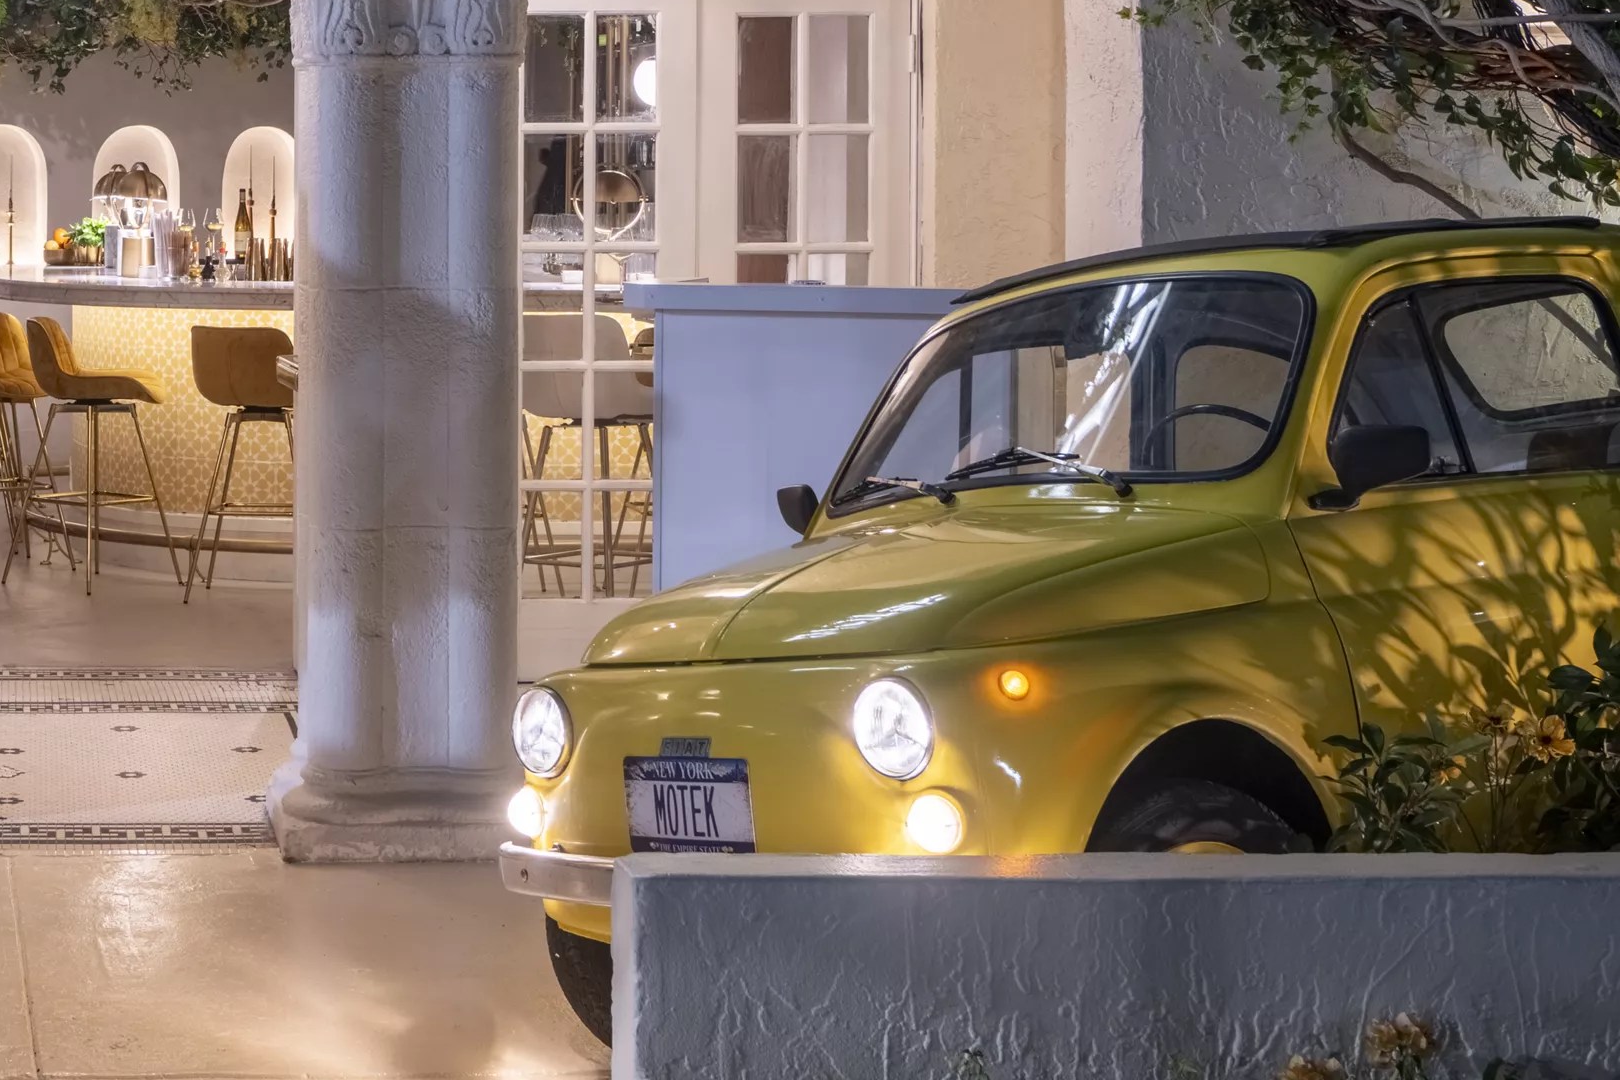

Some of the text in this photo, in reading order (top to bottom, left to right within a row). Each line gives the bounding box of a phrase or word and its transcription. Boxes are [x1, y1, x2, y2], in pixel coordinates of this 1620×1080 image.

[662, 740, 707, 755] FIAT
[652, 761, 715, 780] NEW YORK
[653, 784, 720, 838] MOTEK
[659, 843, 672, 852] THE
